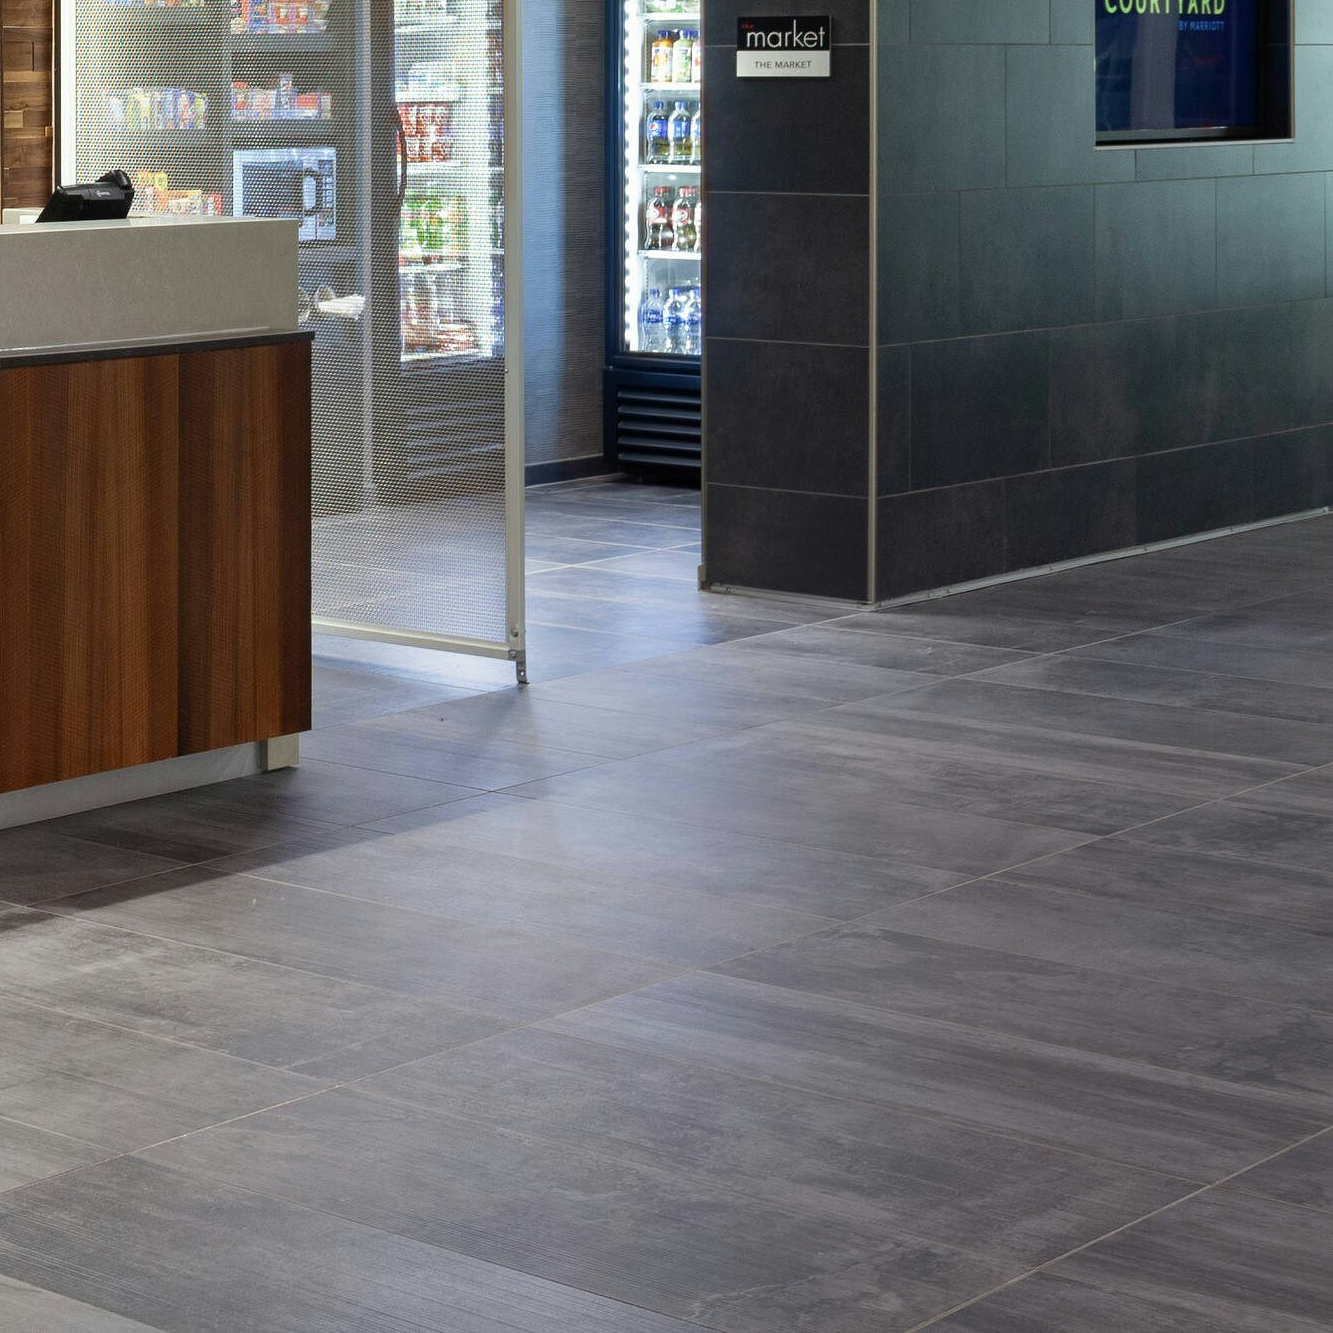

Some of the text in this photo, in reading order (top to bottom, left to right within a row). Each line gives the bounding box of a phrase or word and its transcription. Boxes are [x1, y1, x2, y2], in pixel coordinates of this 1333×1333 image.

[746, 19, 826, 48] market
[755, 60, 812, 69] THE MARKET
